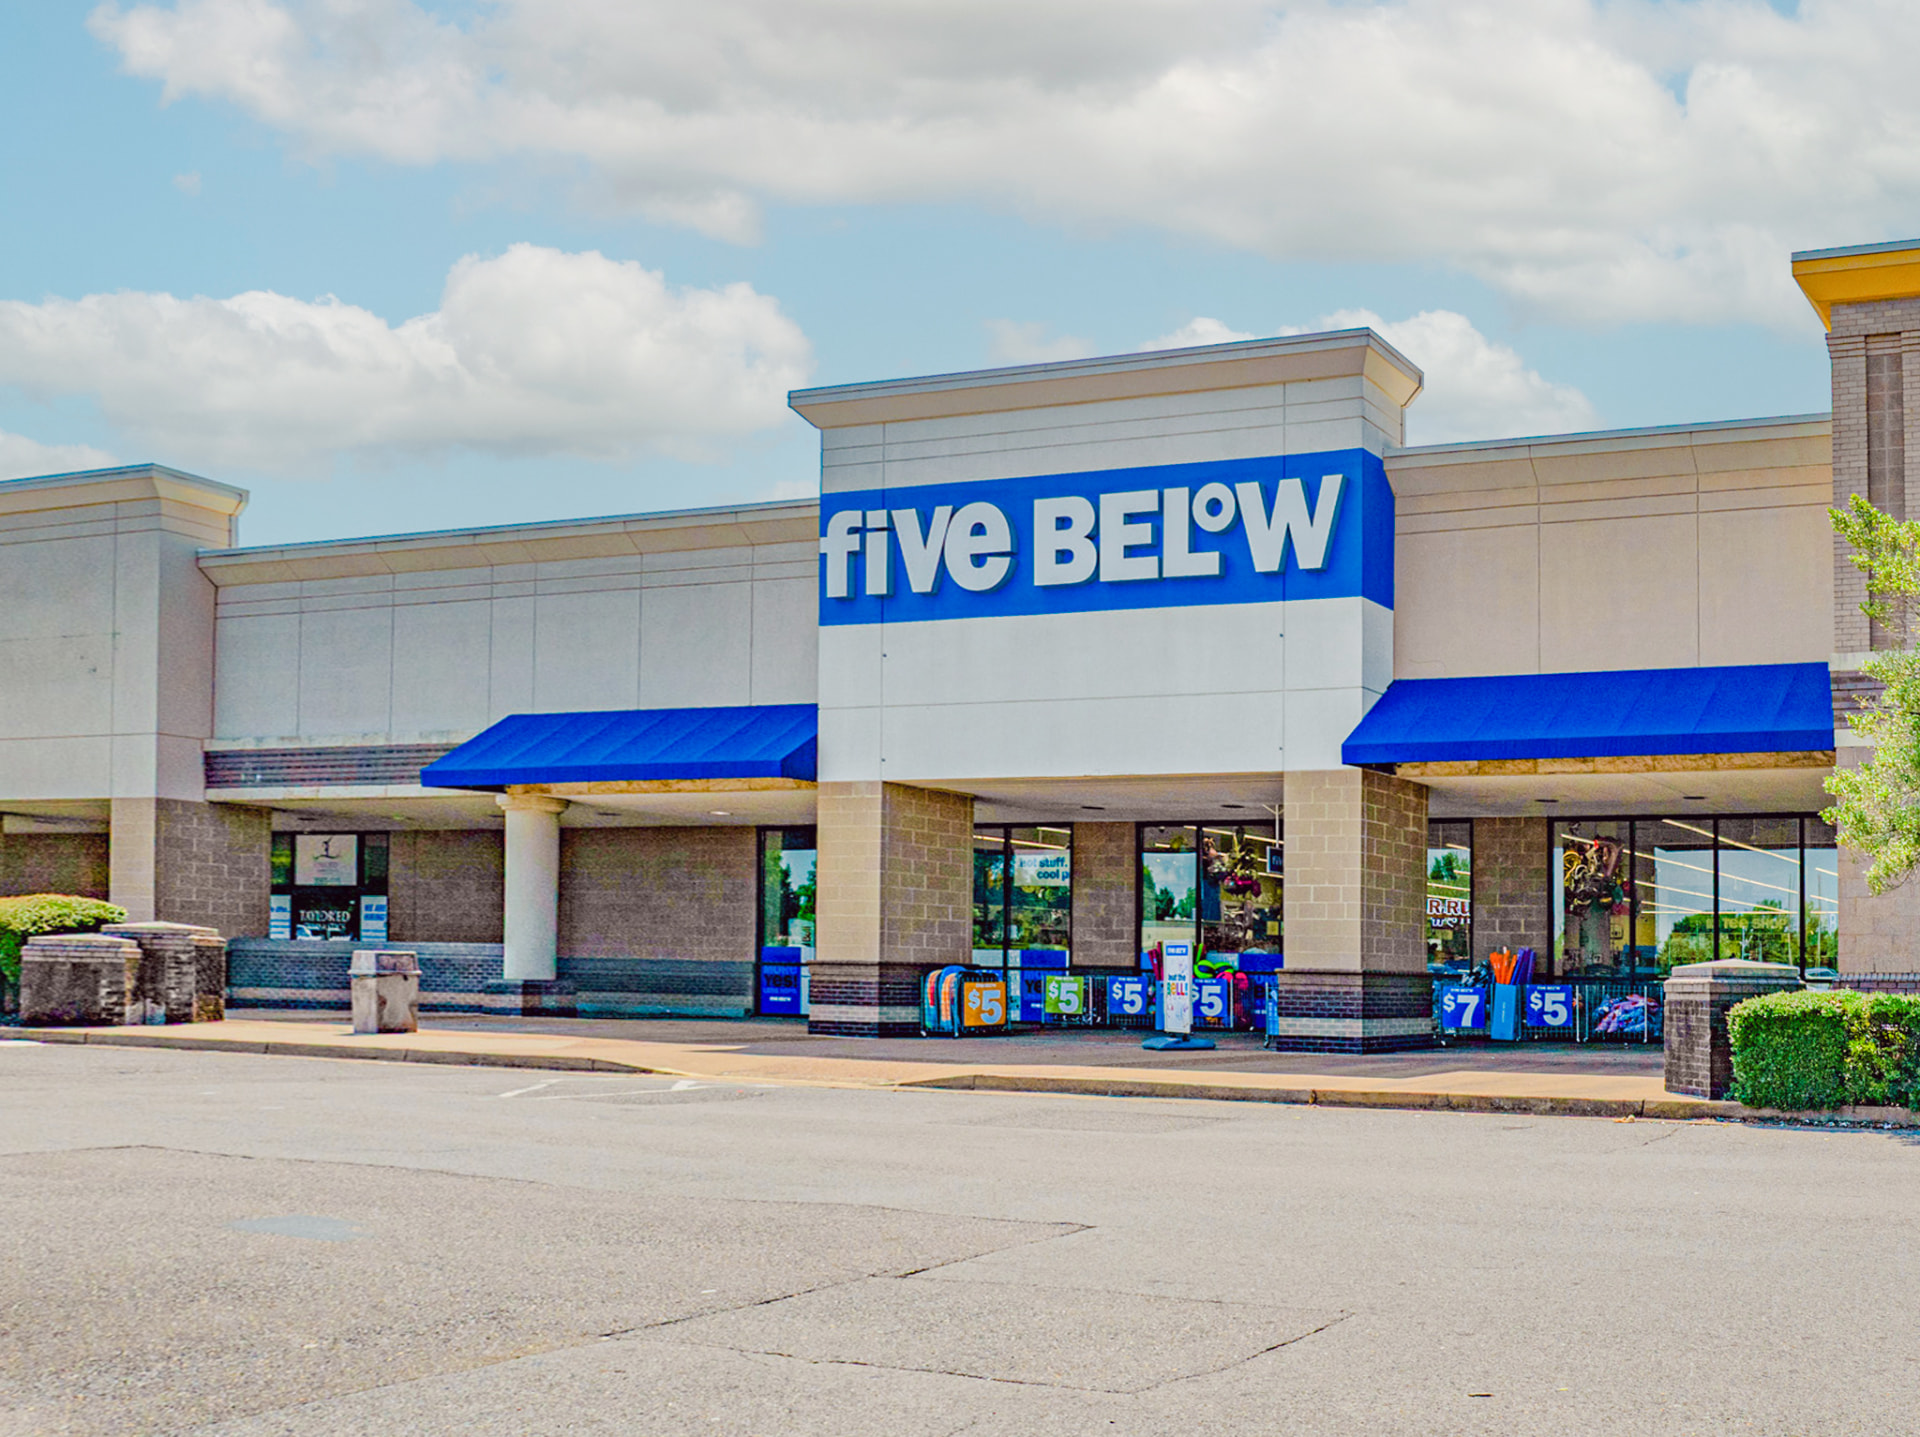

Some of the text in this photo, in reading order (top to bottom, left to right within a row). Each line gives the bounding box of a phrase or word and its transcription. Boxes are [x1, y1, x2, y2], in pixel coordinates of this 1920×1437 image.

[820, 474, 1346, 599] five BELOW
[1036, 869, 1060, 879] cool
[1039, 856, 1068, 868] stuff.
[967, 988, 1003, 1024] $5
[1047, 981, 1079, 1013] $5
[1112, 982, 1143, 1014] $5
[1192, 985, 1223, 1016] $5
[1442, 993, 1479, 1027] $7
[1529, 991, 1568, 1026] $5
